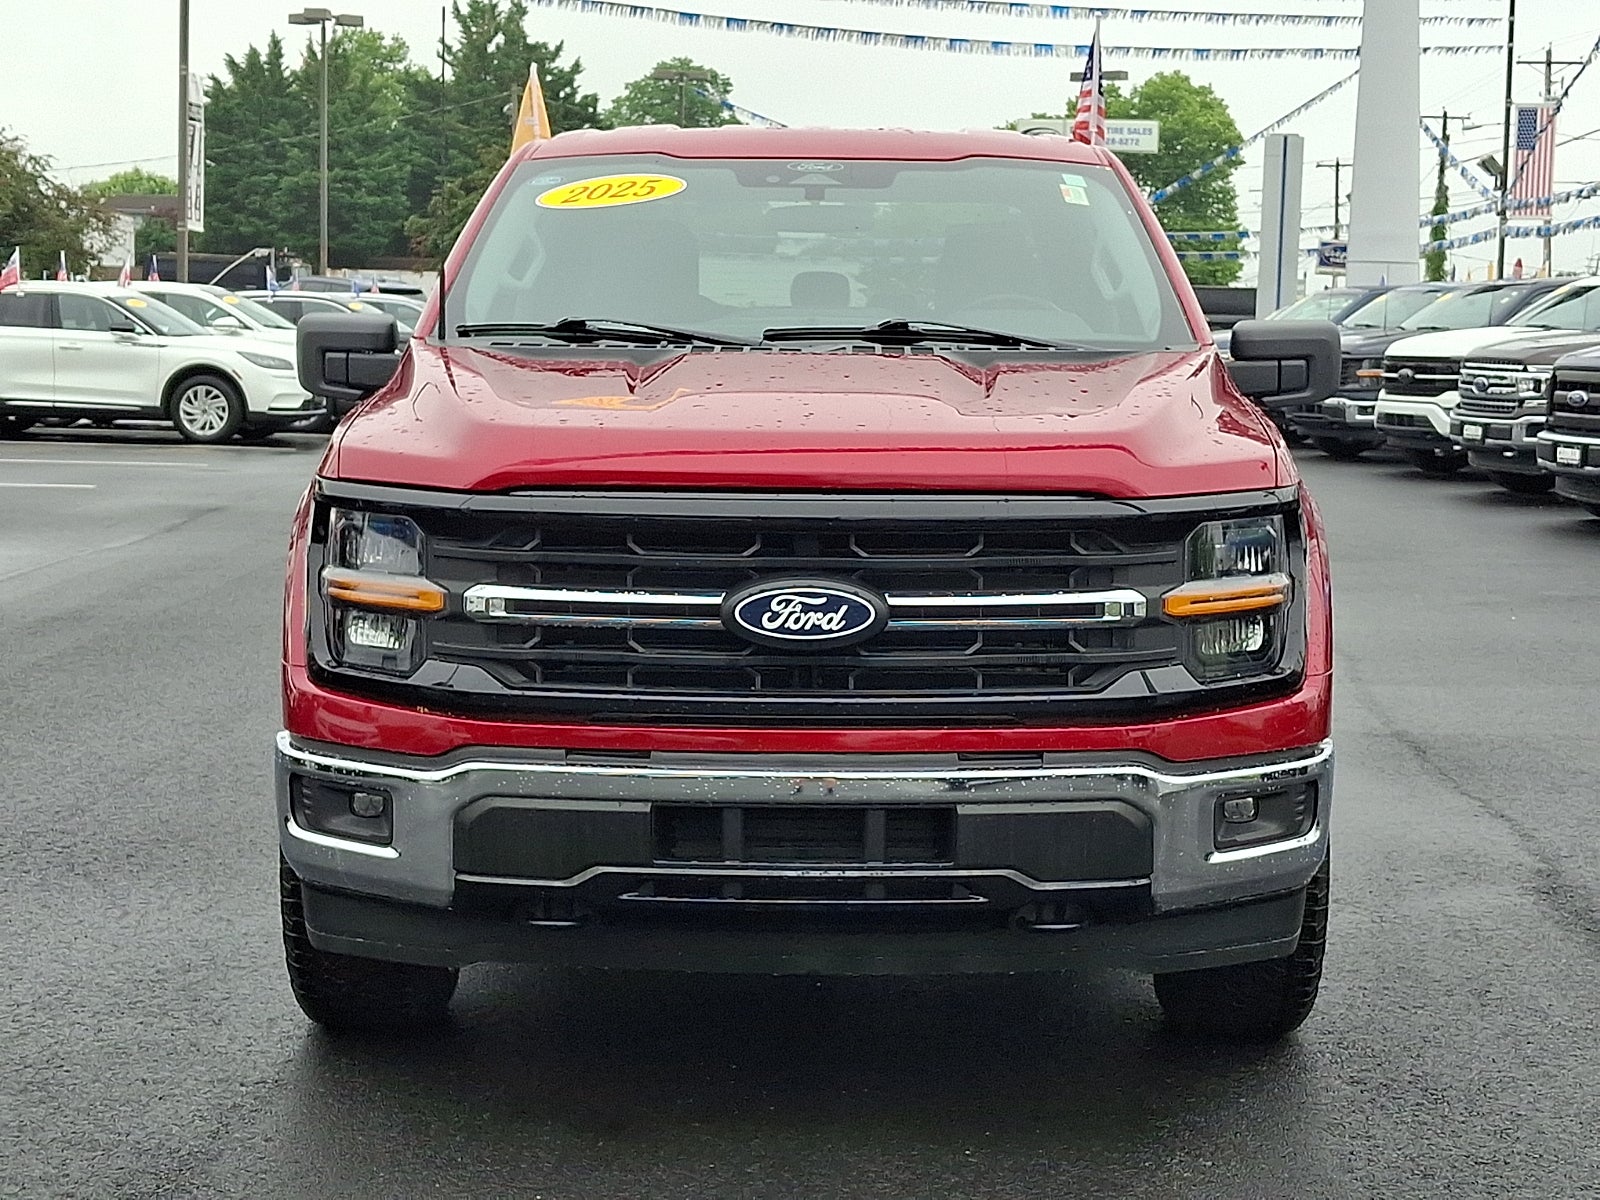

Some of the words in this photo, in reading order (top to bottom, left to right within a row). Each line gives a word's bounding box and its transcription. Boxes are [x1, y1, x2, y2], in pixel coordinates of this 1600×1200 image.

[1106, 127, 1124, 135] TIRE
[1127, 127, 1153, 136] SALES
[560, 179, 663, 204] 2025
[761, 594, 849, 631] Ford
